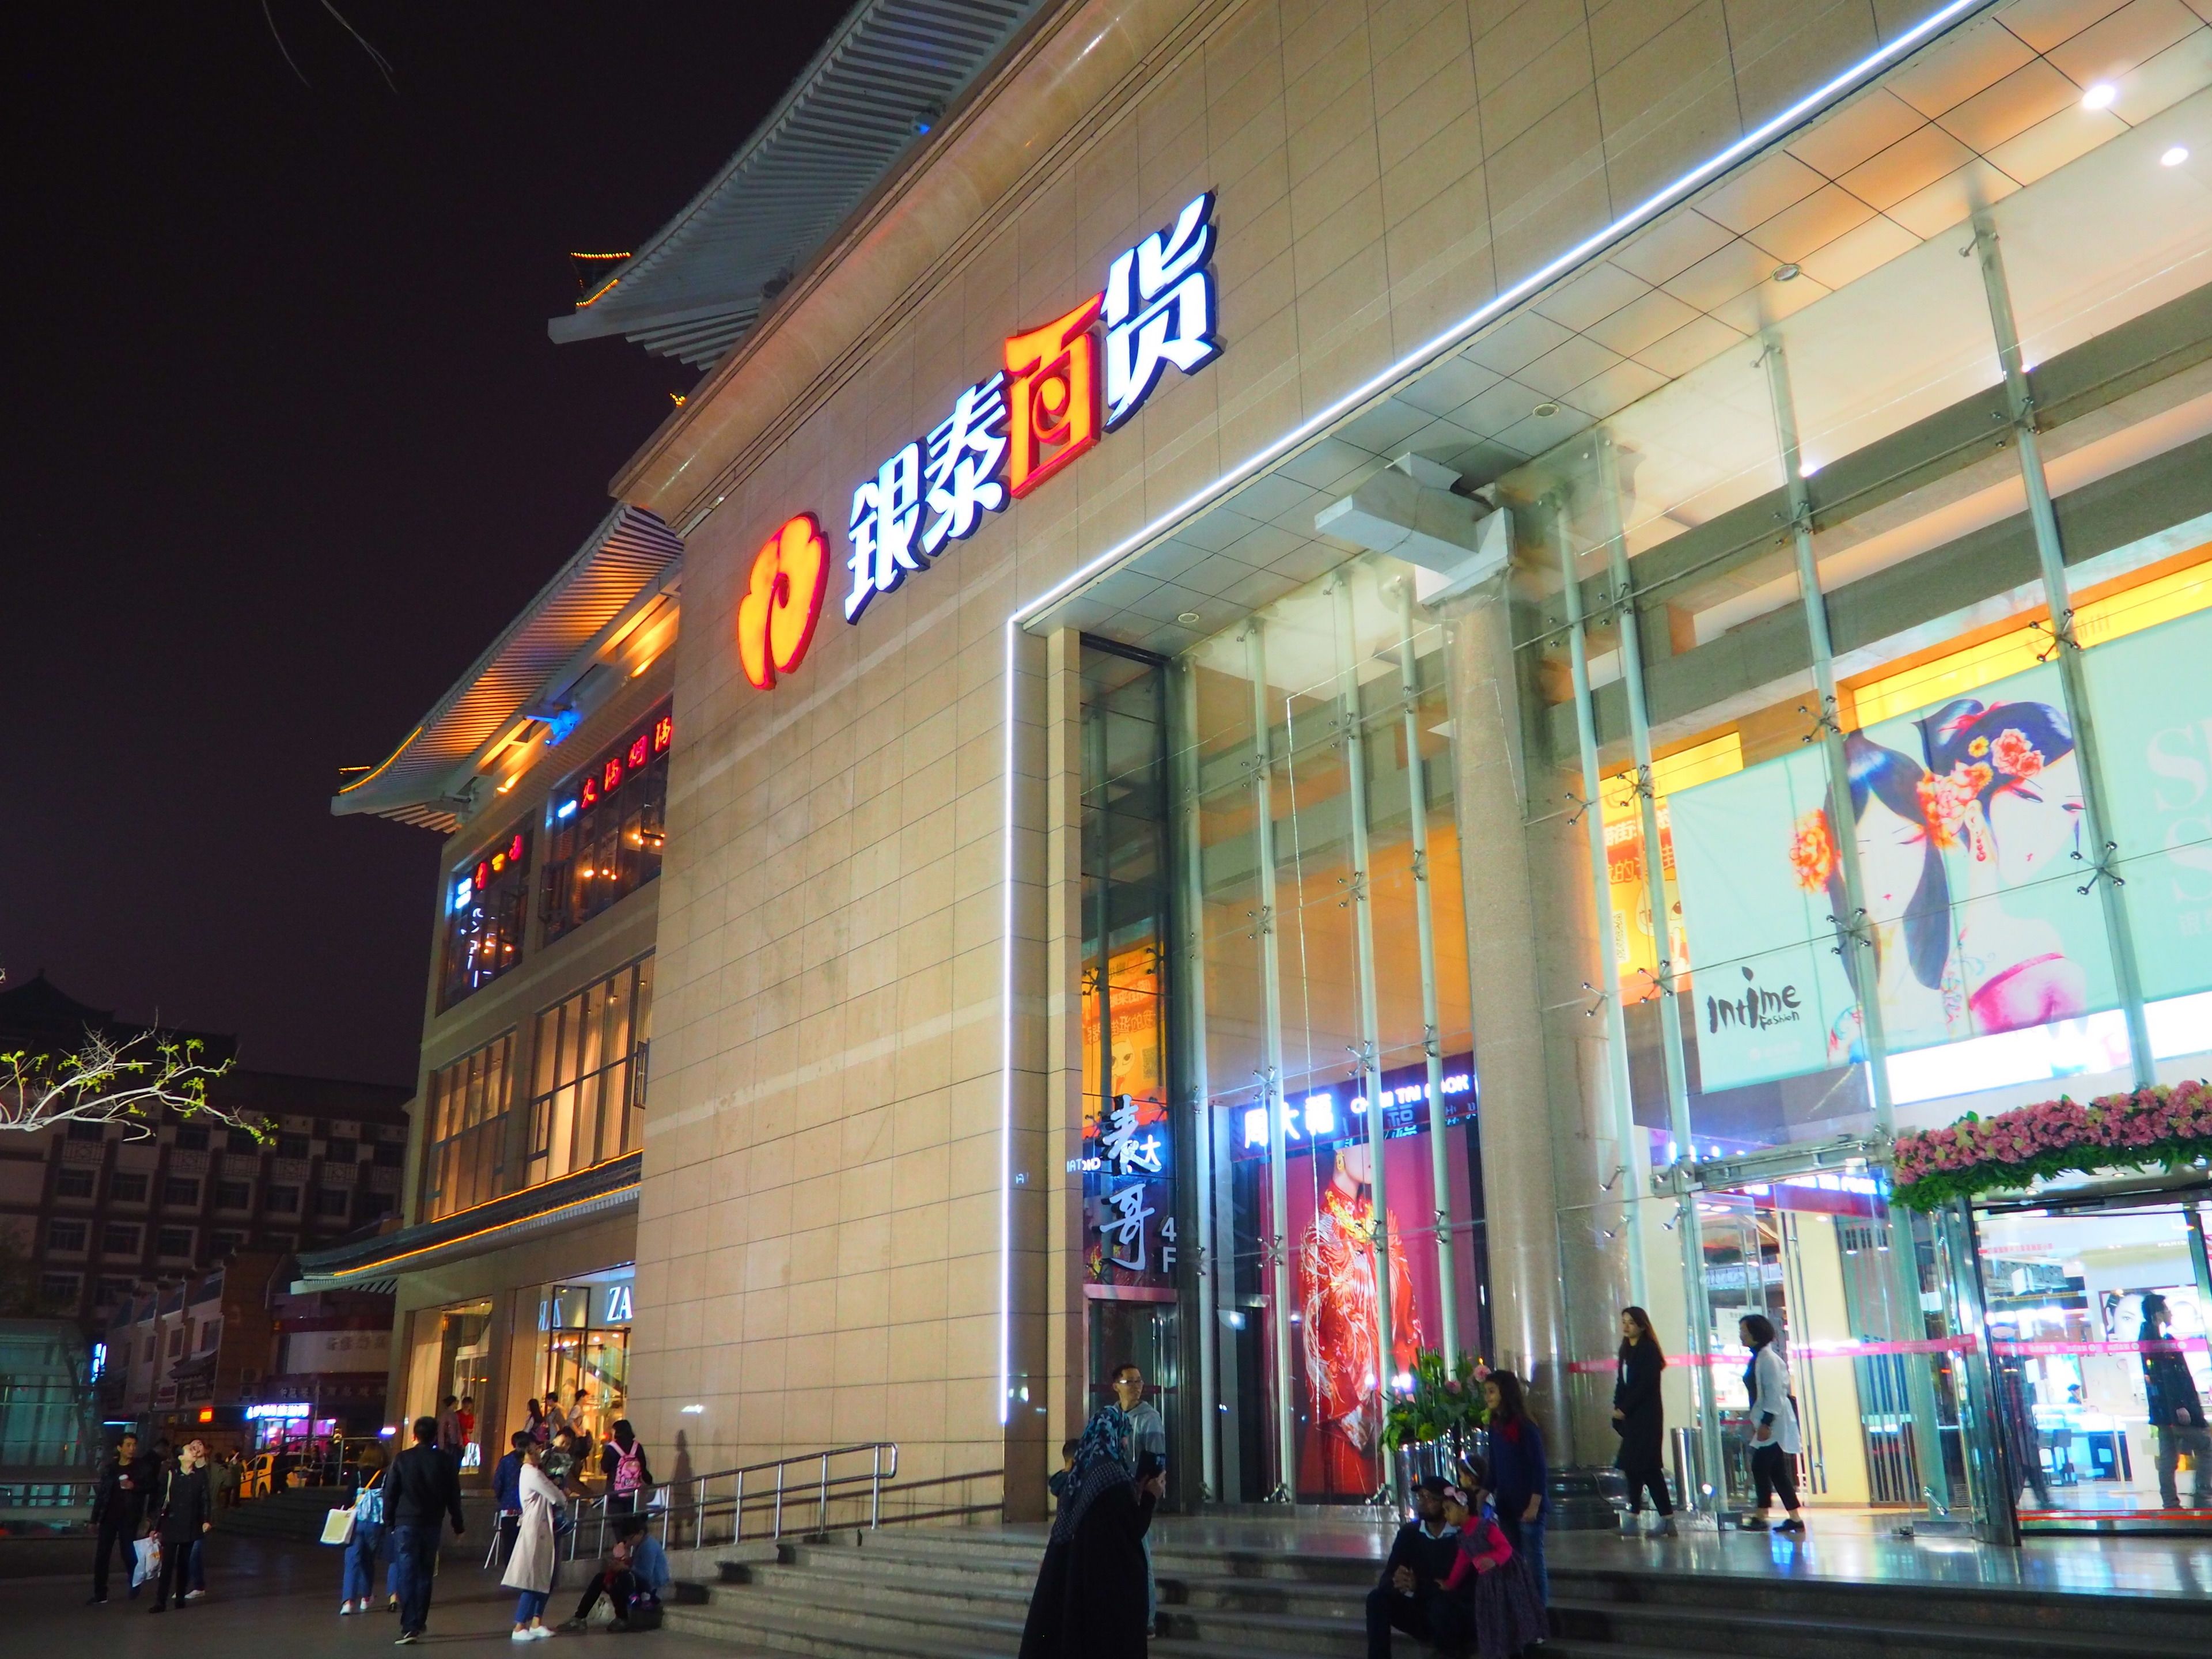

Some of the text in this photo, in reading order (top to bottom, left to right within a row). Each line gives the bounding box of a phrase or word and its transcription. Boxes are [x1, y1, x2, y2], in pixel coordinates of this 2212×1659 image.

[844, 192, 1217, 624] 银泰百货
[1425, 1074, 1469, 1099] FOK
